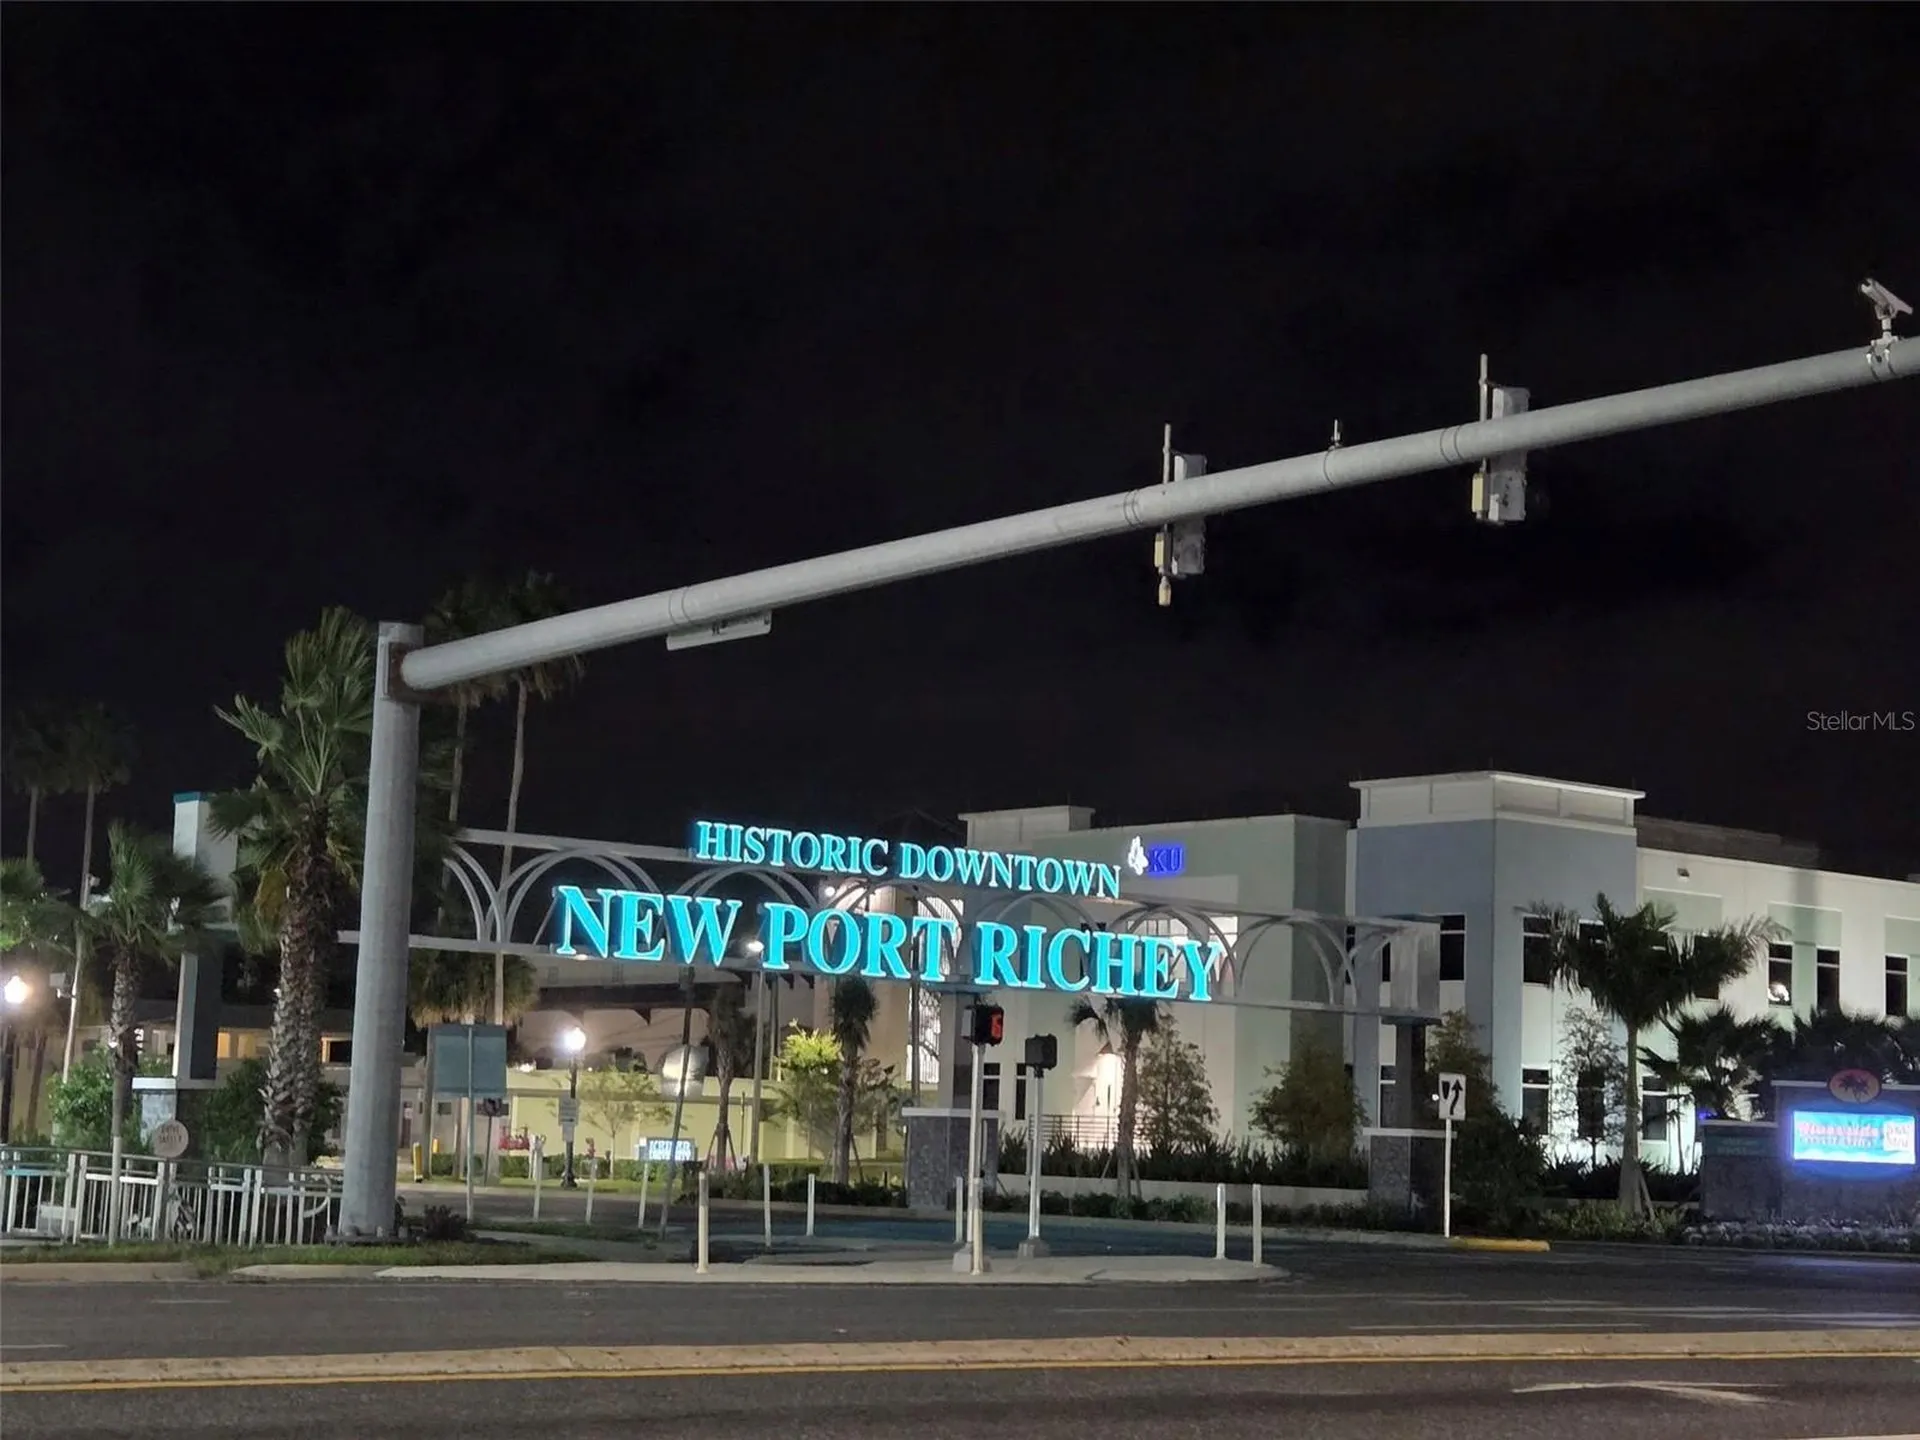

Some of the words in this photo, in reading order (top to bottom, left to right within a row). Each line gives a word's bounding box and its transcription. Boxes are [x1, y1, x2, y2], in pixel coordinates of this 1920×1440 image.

[696, 821, 890, 877] HISTORIC
[899, 842, 1121, 899] DOWNTOWN
[1150, 847, 1184, 873] KU
[556, 885, 742, 967] NEW
[762, 902, 957, 982] PORT
[974, 921, 1222, 1002] RICHEY
